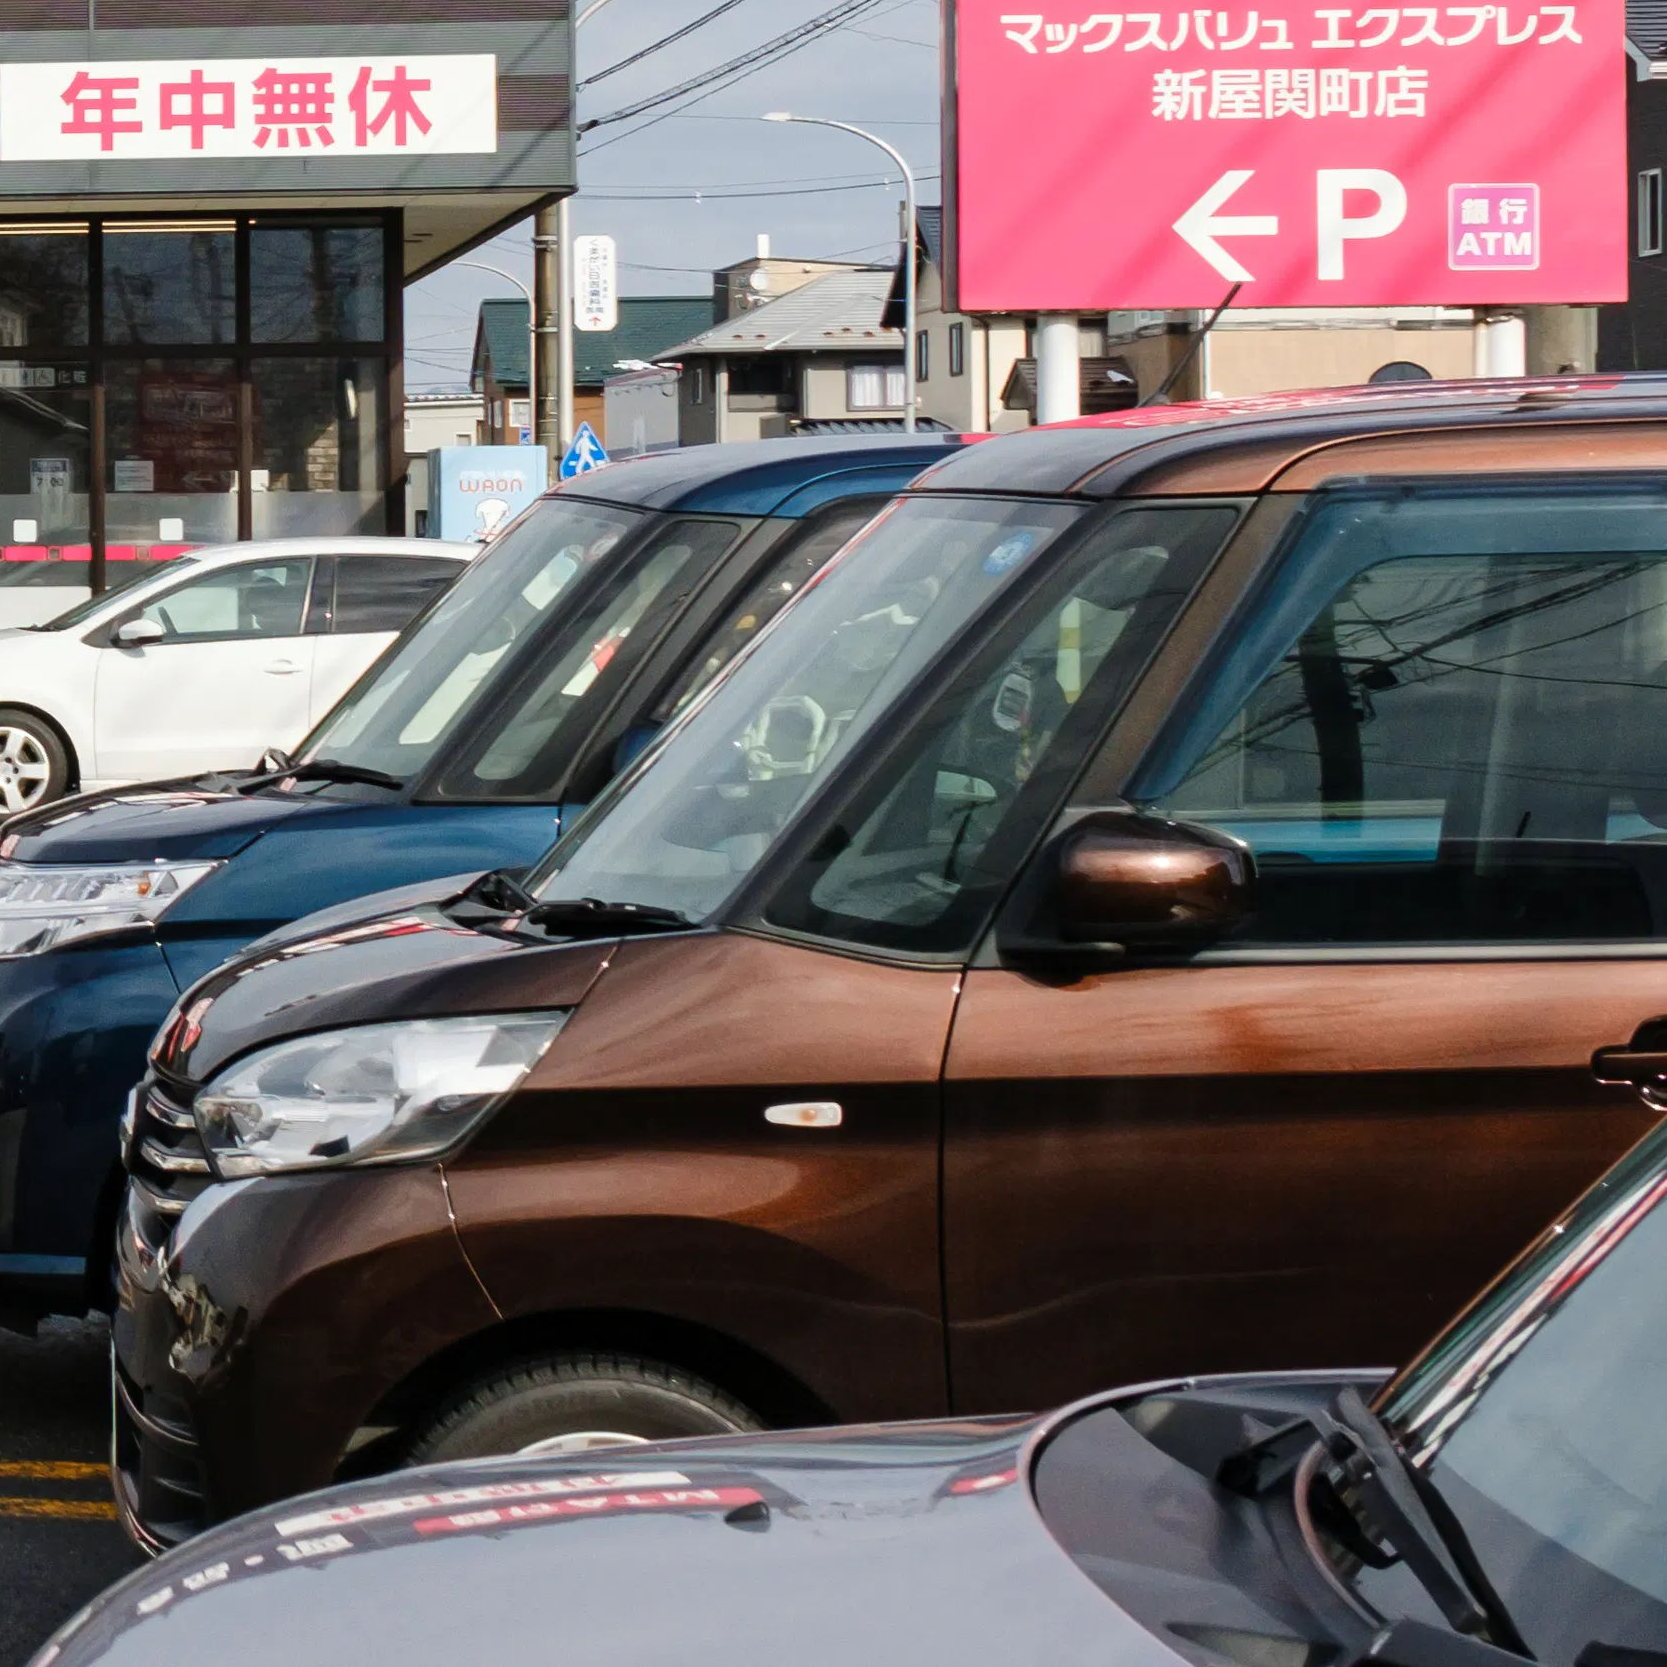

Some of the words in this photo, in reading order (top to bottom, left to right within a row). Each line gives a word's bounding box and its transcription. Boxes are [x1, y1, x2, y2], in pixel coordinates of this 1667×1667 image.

[999, 9, 1294, 55] マックスバリュ
[1312, 3, 1583, 50] エクスプレス
[60, 65, 434, 151] 年中無休
[1151, 65, 1429, 122] 新屋関町店
[1316, 168, 1408, 281] P
[1461, 198, 1528, 224] 銀行
[1456, 231, 1533, 257] ATM
[459, 478, 524, 494] WAON
